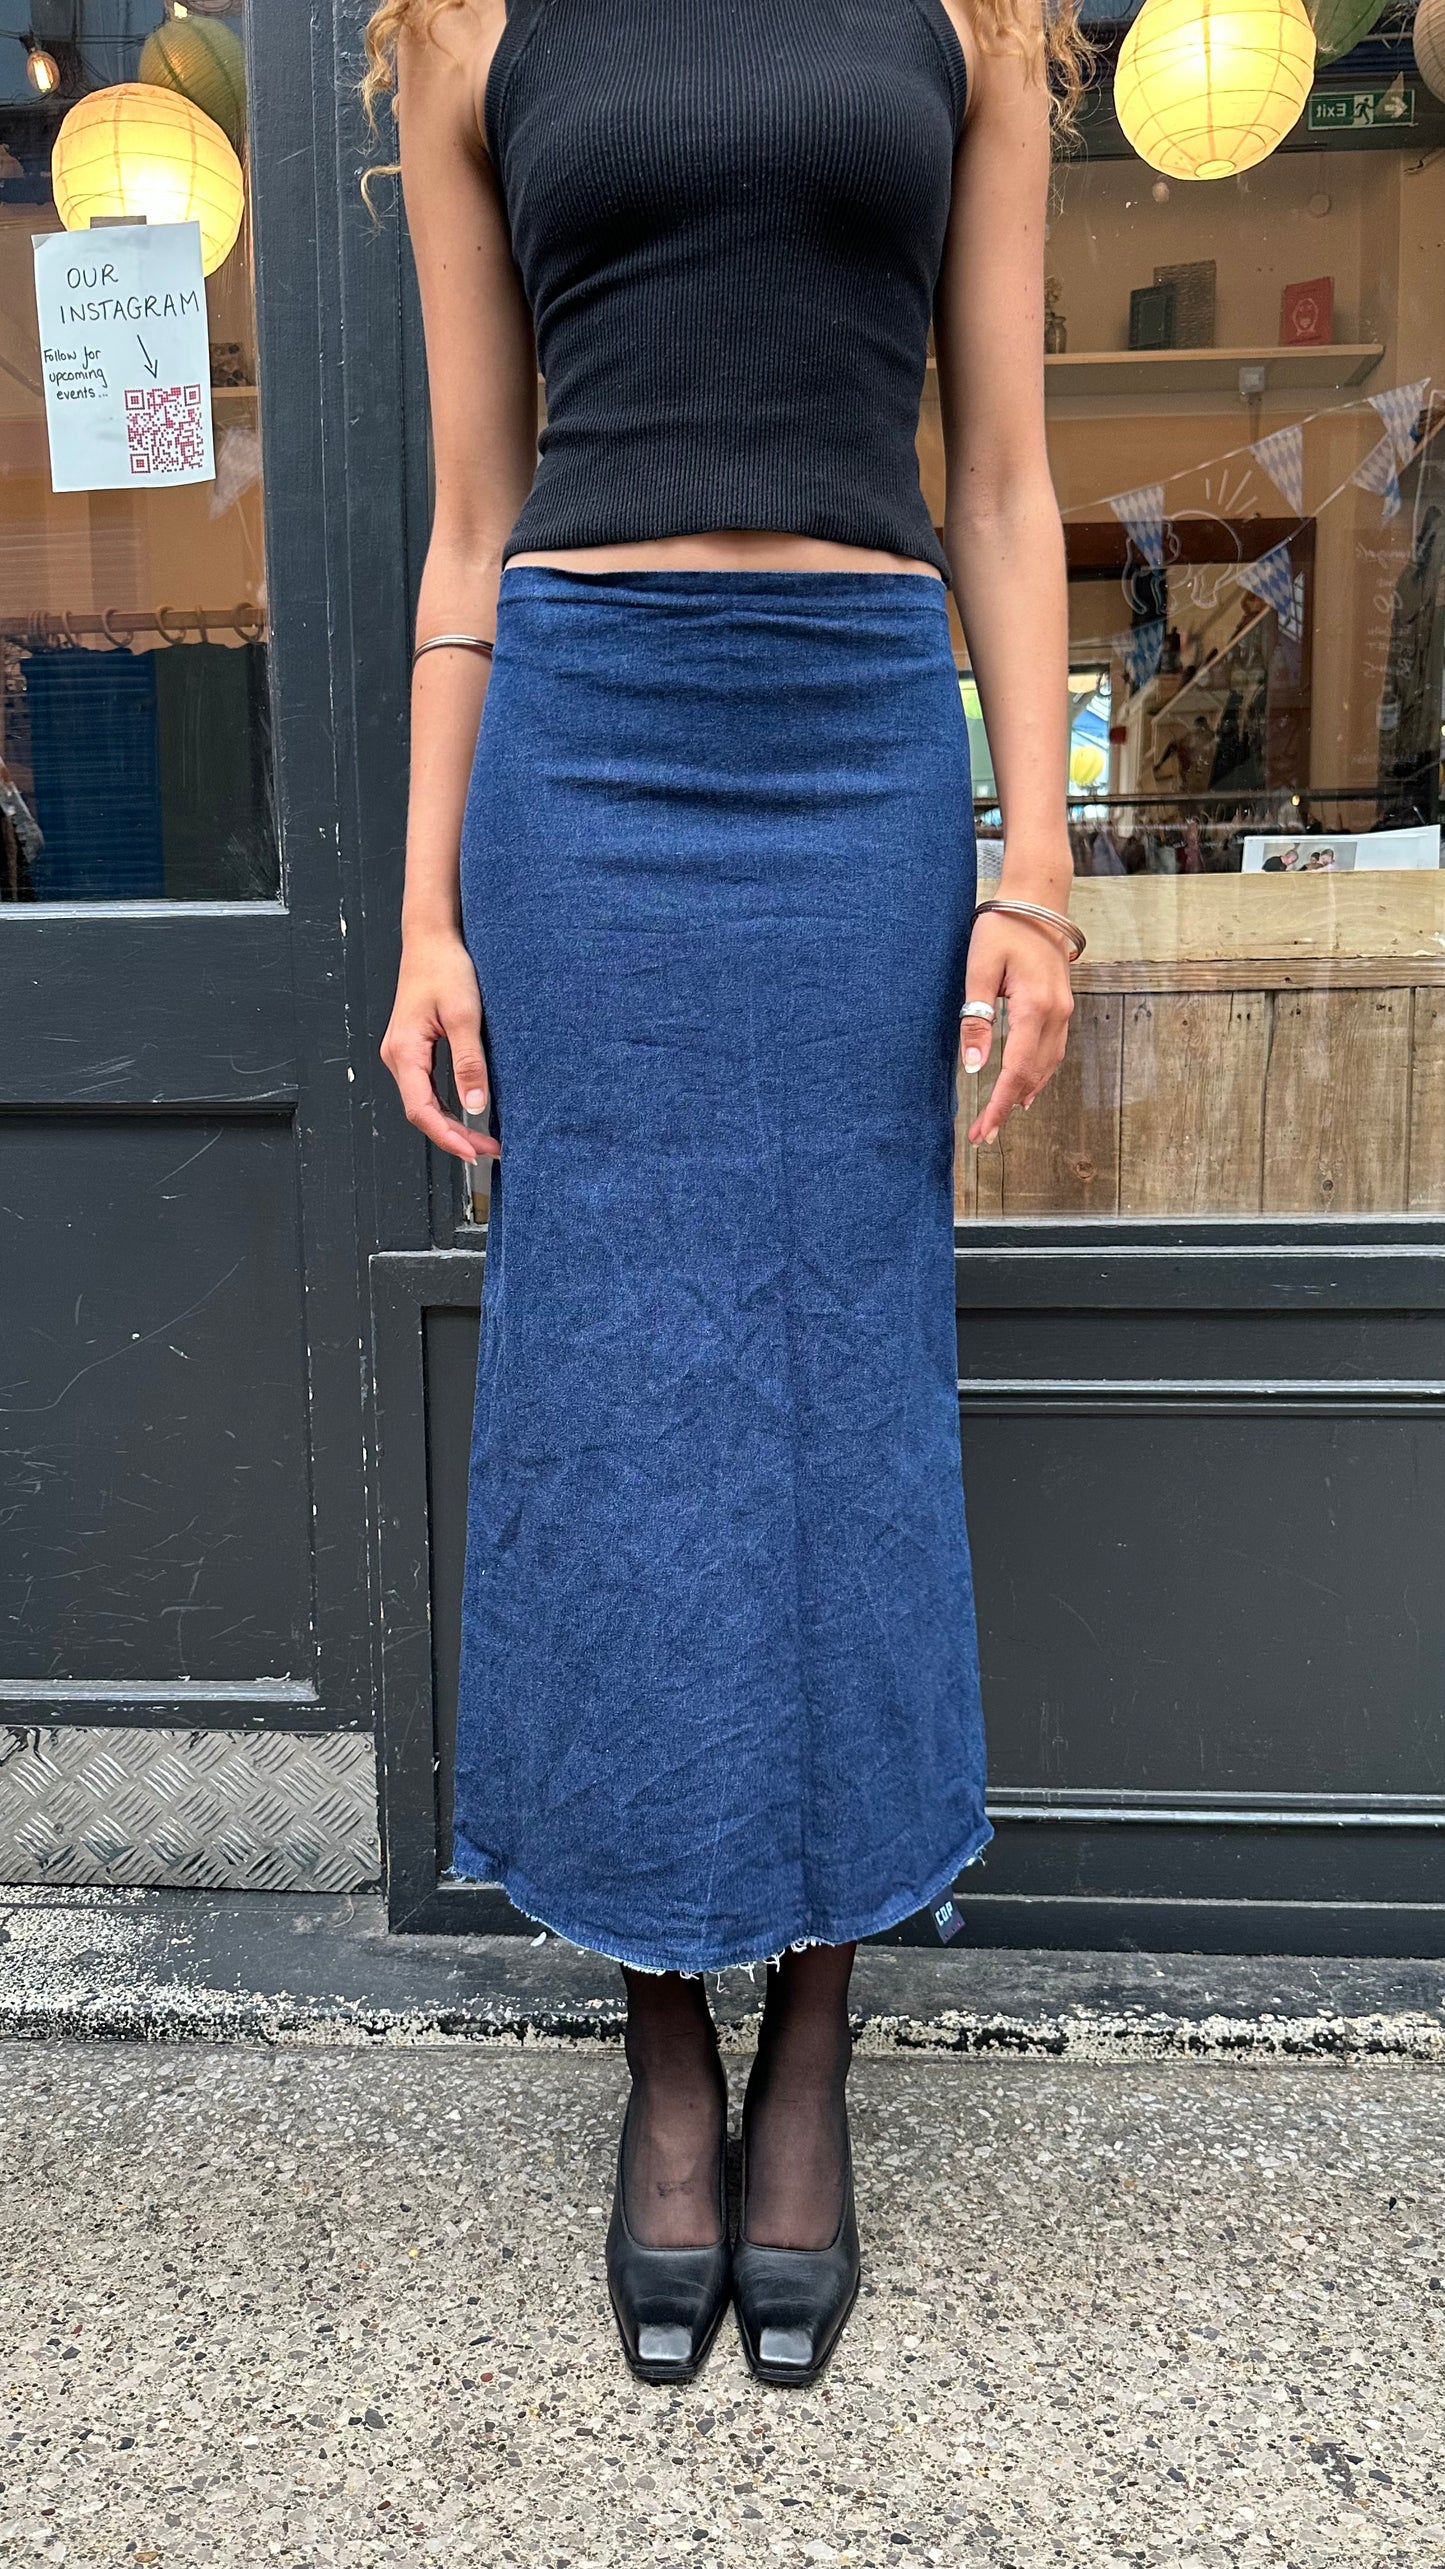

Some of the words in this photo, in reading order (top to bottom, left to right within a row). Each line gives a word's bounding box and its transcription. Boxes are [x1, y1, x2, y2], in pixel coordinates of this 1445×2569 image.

[67, 264, 119, 288] OUR
[60, 290, 199, 324] INSTAGRAM
[43, 349, 77, 363] Follow
[82, 346, 101, 369] for
[49, 369, 108, 388] upcoming
